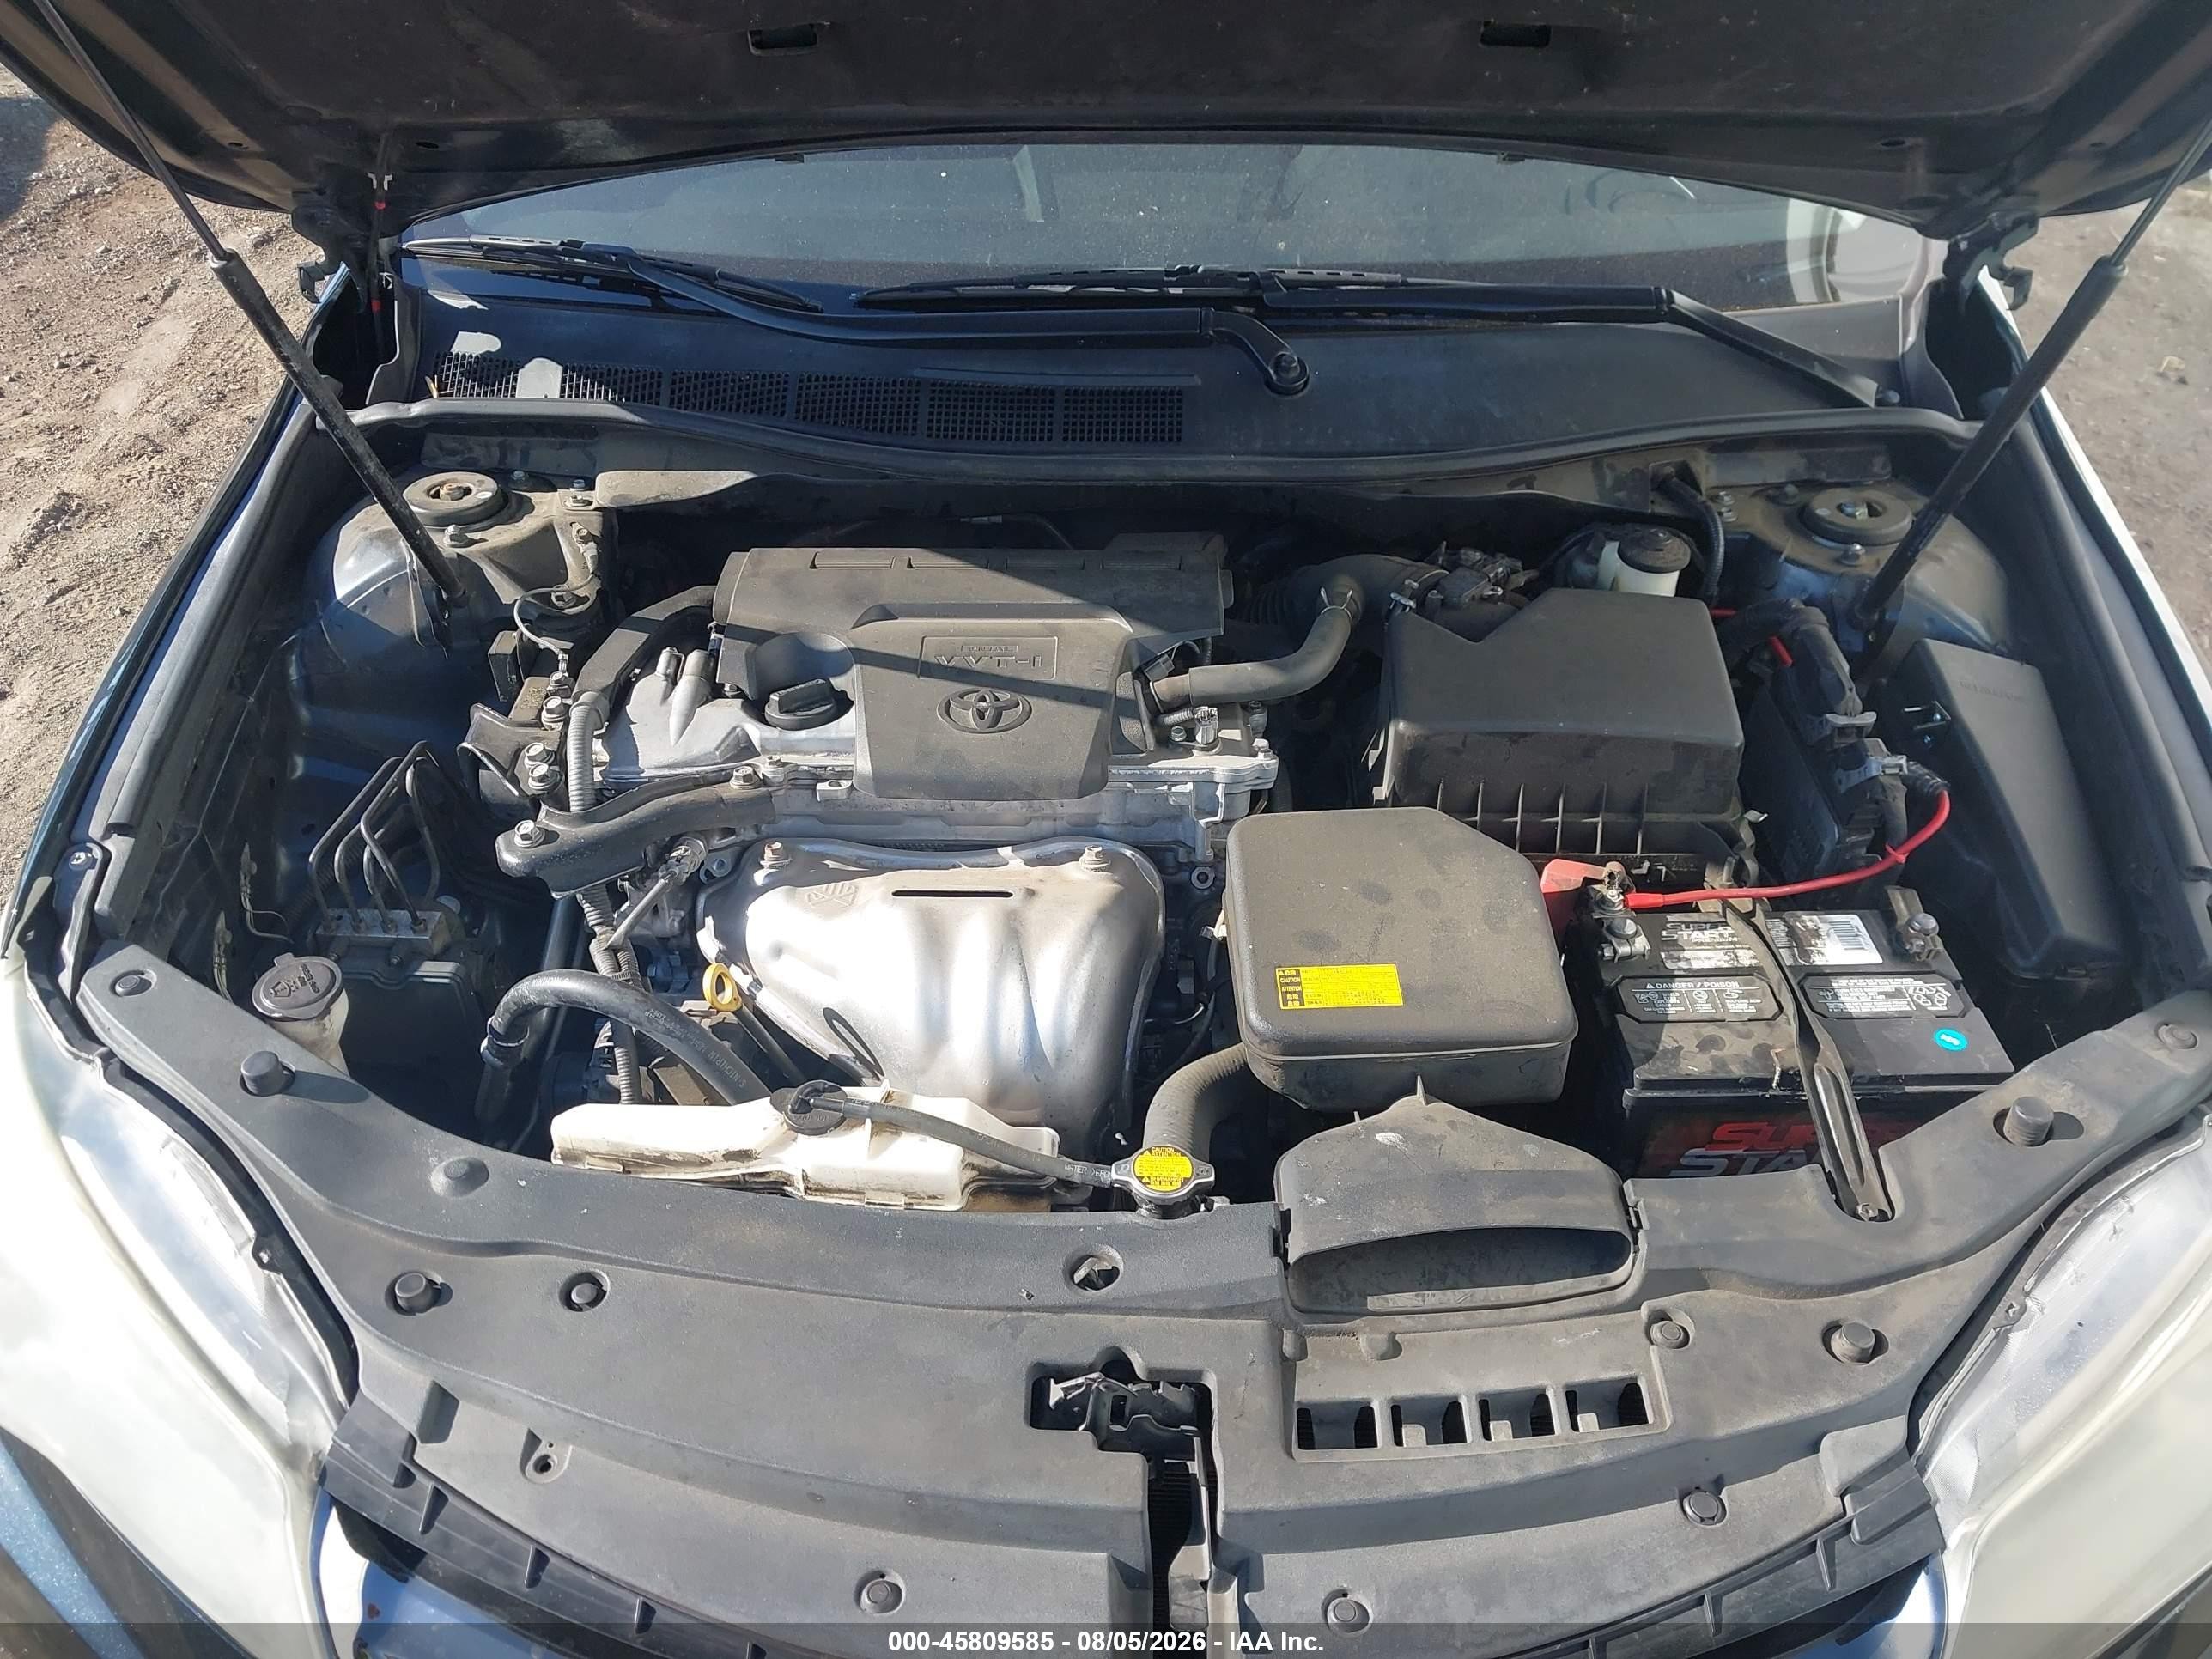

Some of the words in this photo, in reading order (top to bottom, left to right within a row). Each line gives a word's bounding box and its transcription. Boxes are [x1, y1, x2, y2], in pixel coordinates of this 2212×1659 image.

[934, 655, 1042, 668] VVT-i
[1661, 929, 1735, 941] START
[1704, 981, 1741, 989] POISON
